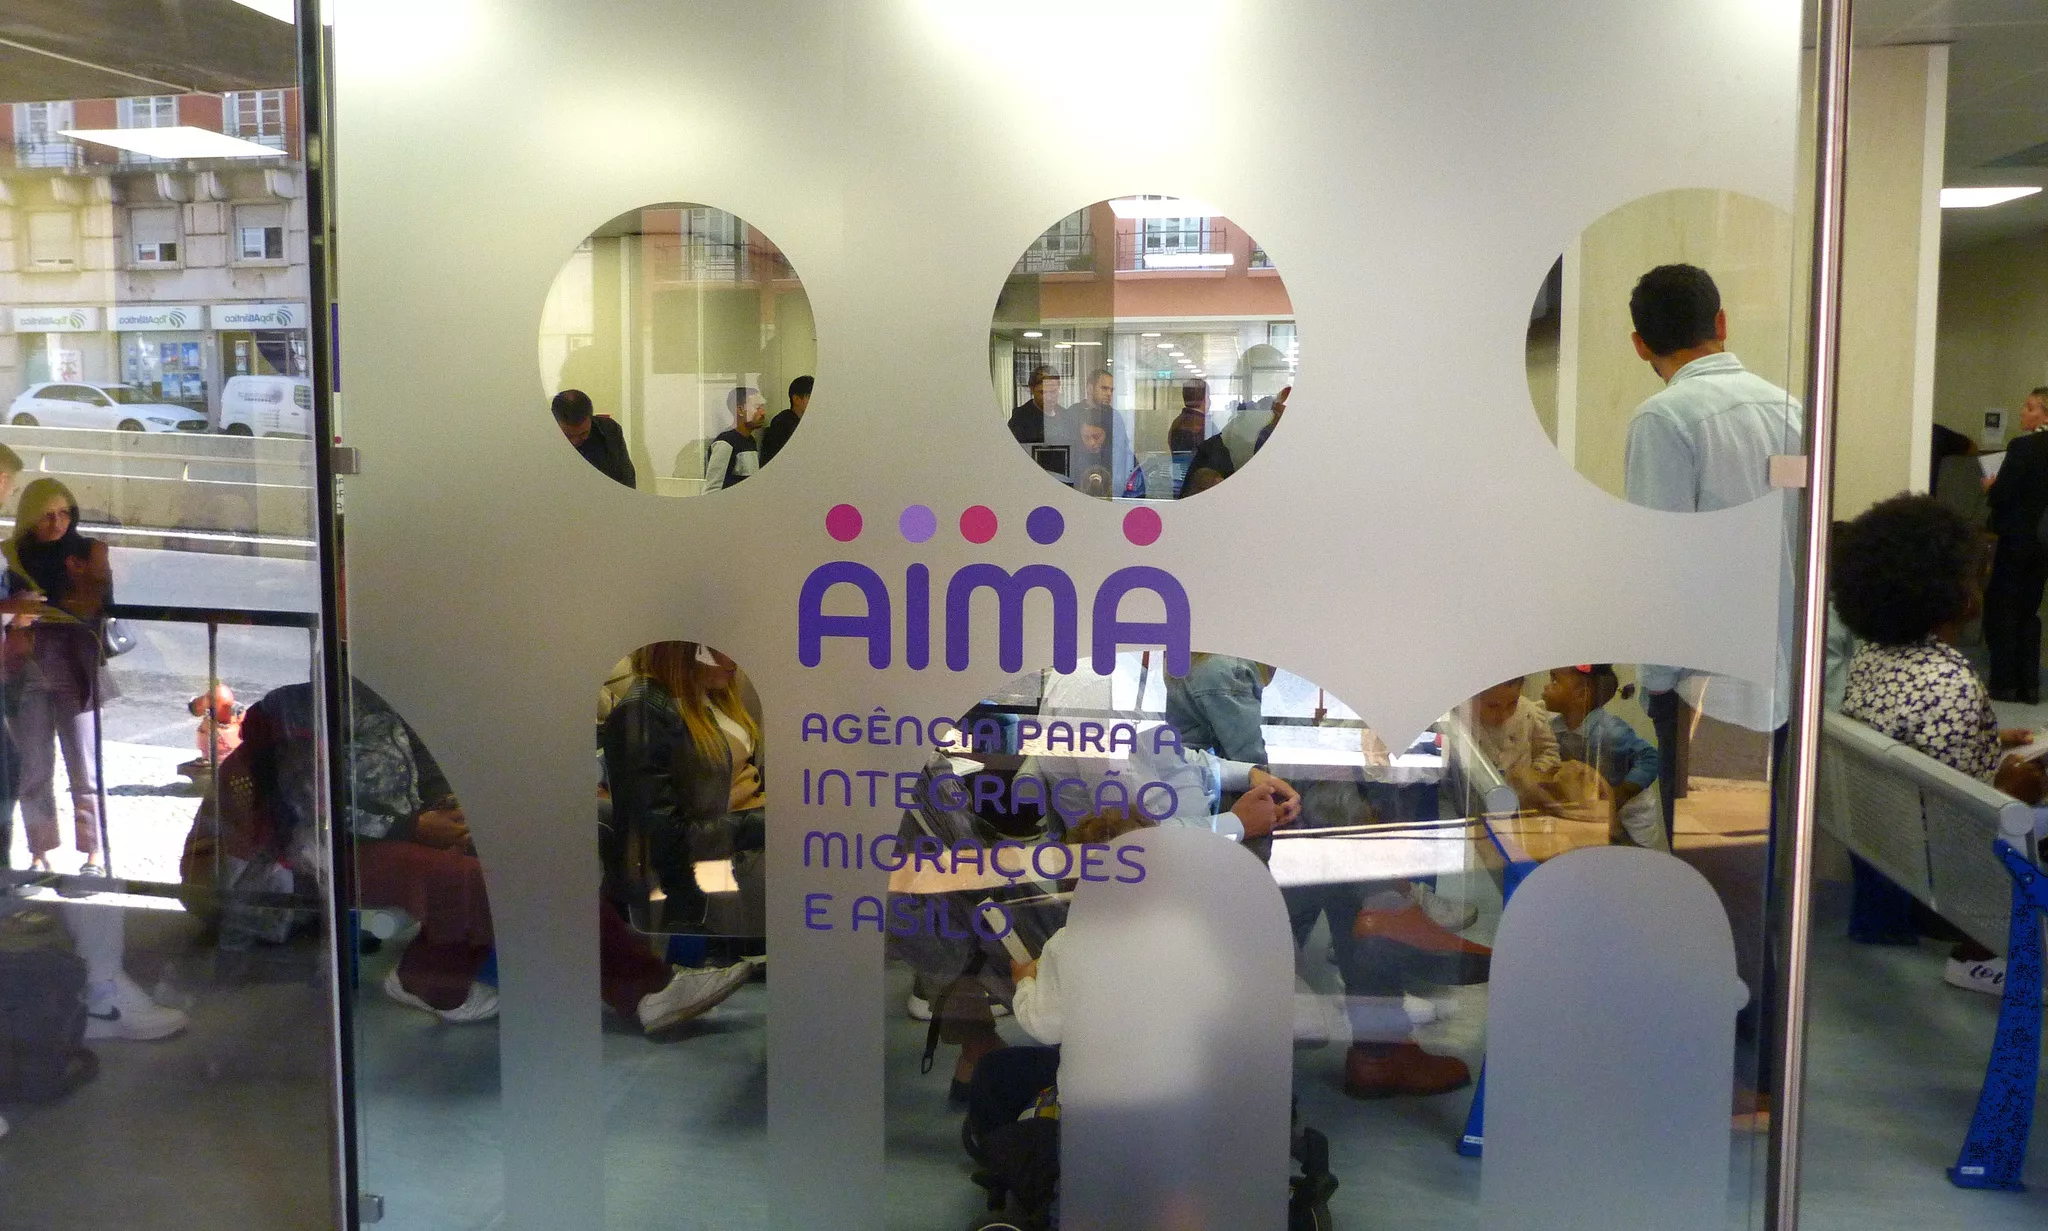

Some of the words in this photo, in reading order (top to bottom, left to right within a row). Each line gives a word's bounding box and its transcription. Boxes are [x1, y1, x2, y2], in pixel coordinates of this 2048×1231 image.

[801, 706, 1001, 750] AGÊNCIA
[1017, 719, 1137, 753] PARA
[1153, 723, 1182, 755] A
[803, 768, 1180, 826] INTEGRAÇÃO
[803, 831, 1147, 888] MIGRAÇÕES
[805, 893, 834, 931] E
[852, 896, 1013, 941] ASILO
